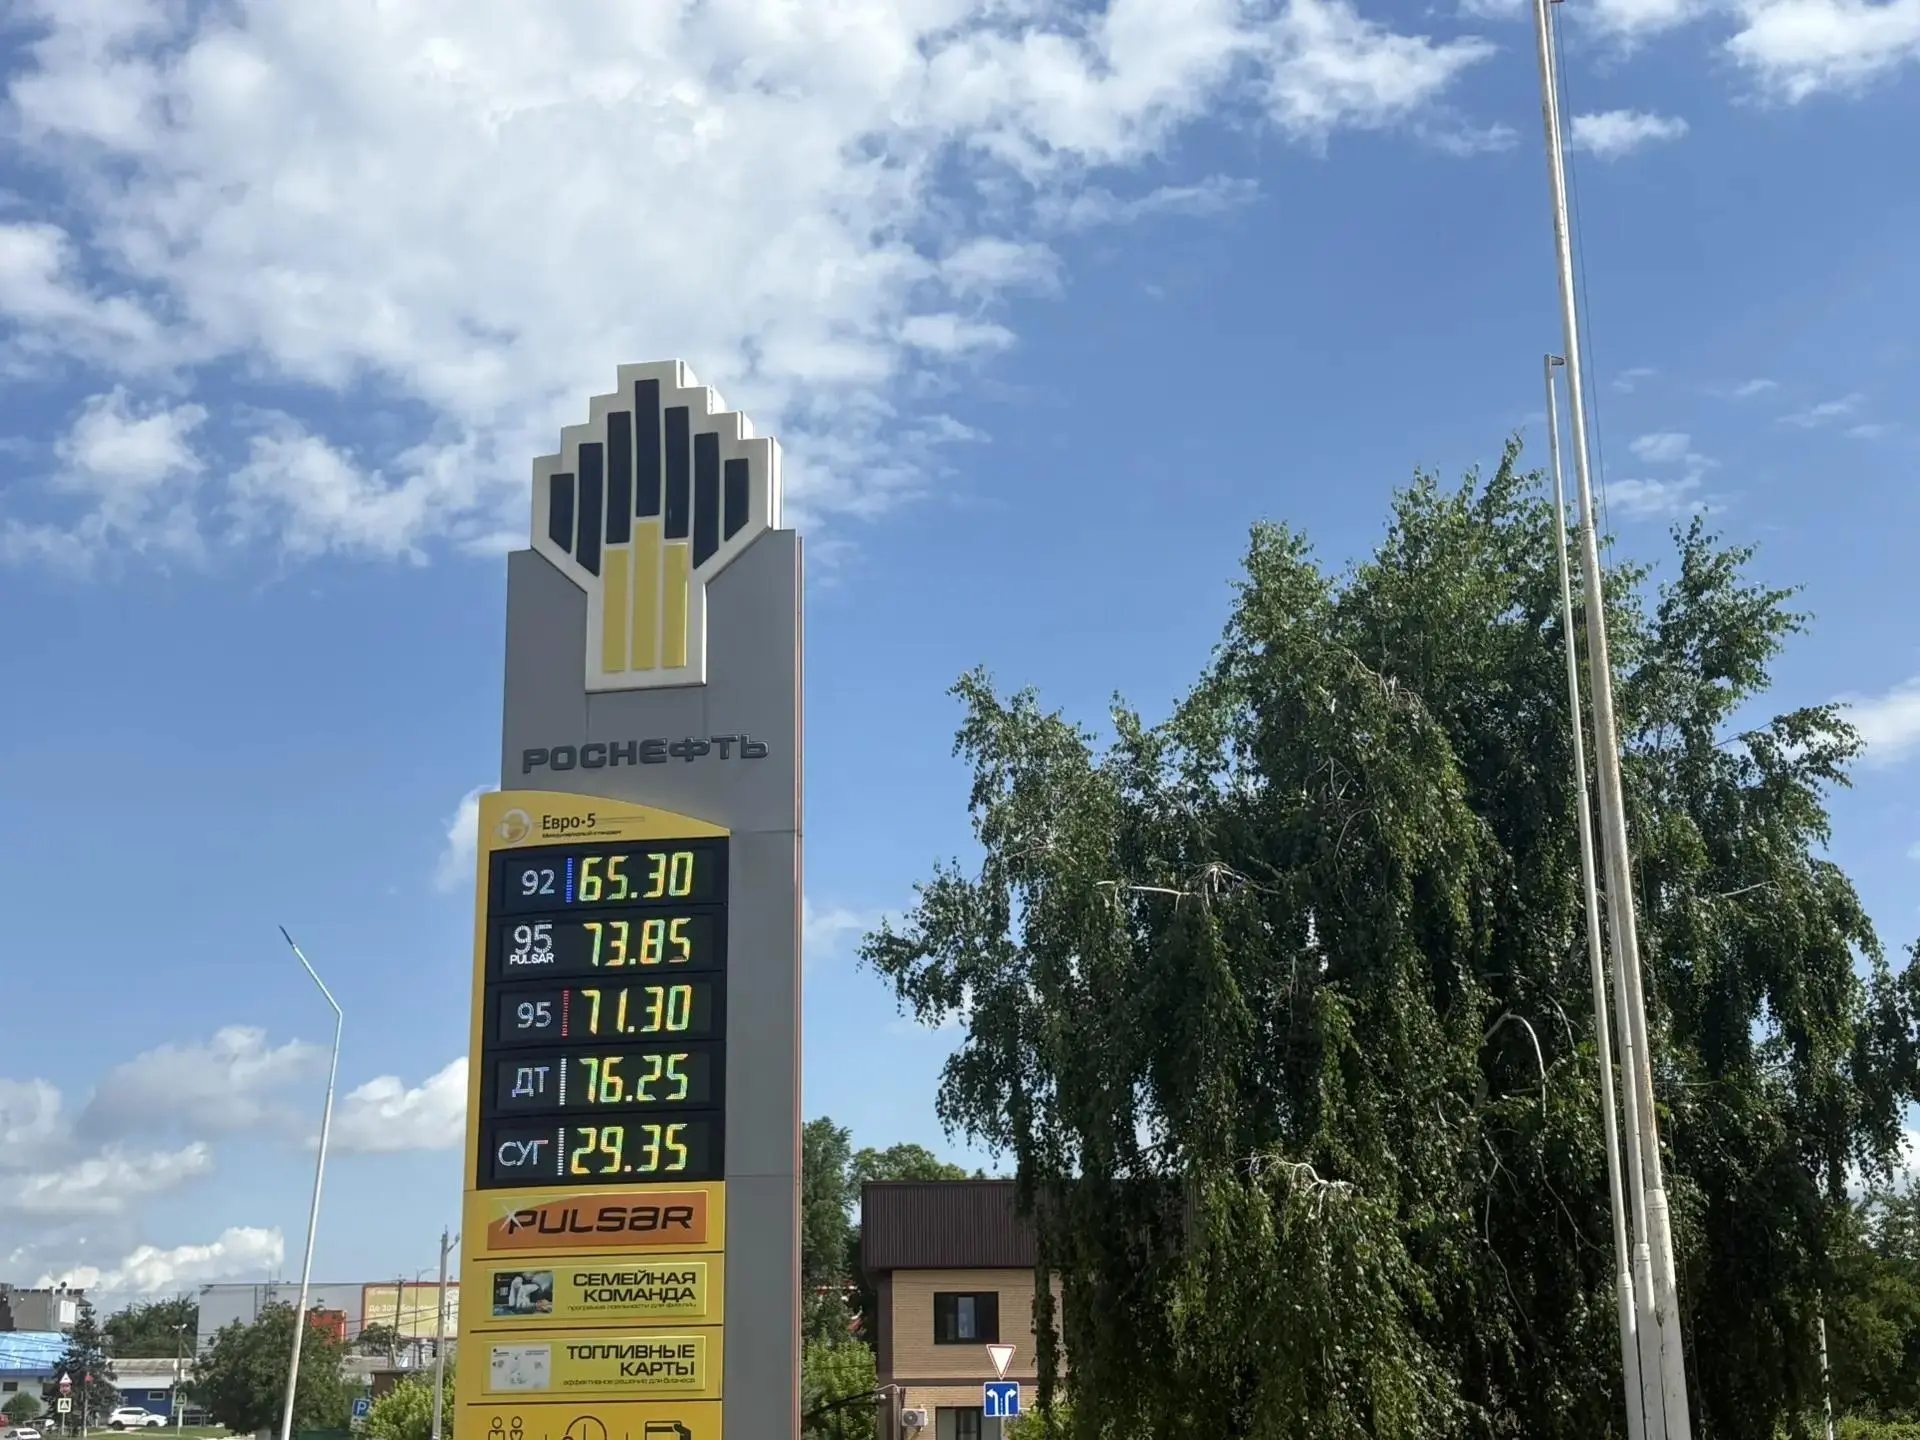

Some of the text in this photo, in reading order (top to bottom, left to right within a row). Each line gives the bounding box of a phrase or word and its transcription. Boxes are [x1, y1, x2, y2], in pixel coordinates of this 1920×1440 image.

[522, 734, 769, 774] РОСНЕФТЬ
[521, 851, 694, 902] 92 65.30
[509, 952, 554, 965] PULSAR
[513, 917, 692, 967] 95 73.85
[517, 984, 692, 1035] 95 71.30
[511, 1053, 689, 1104] ДТ 76.25
[498, 1123, 688, 1175] СУГ 29.35
[573, 1269, 697, 1288] СЕМЕЙНАЯ
[584, 1287, 696, 1304] КОМАНДА
[566, 1344, 695, 1360] ТОПЛИВНЫЕ
[619, 1361, 695, 1377] КАРТЫ
